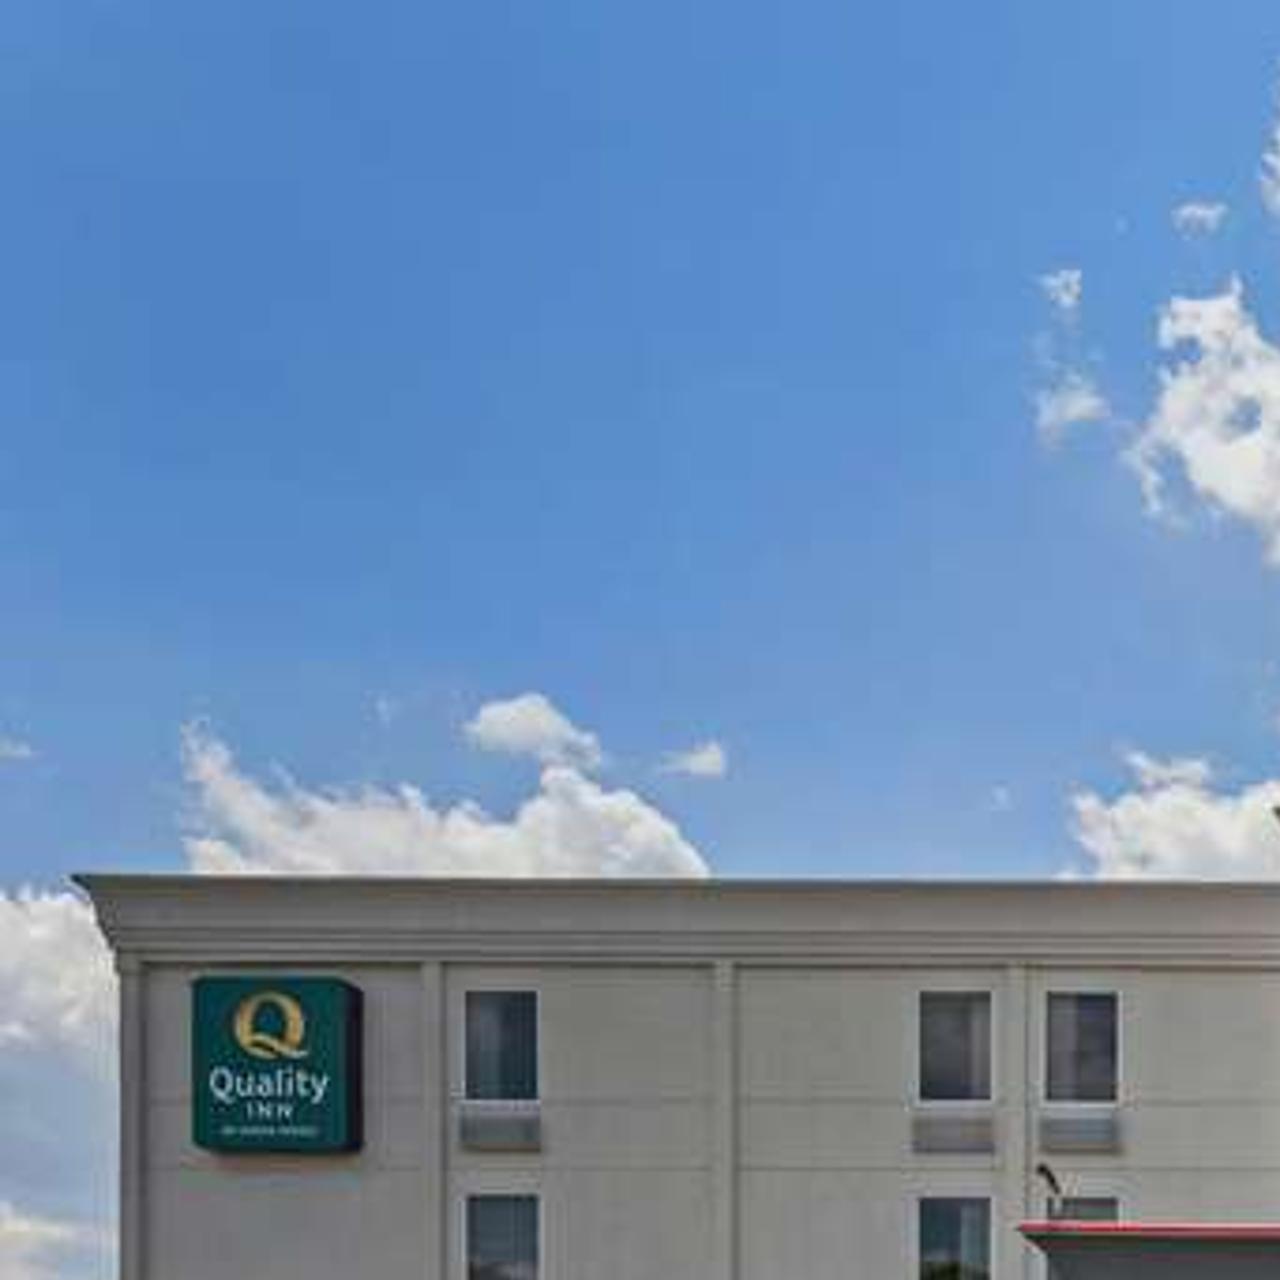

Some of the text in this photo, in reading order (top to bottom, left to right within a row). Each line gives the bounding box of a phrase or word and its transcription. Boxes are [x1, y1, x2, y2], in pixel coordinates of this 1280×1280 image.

[235, 991, 309, 1059] Q
[209, 1066, 328, 1104] Quality
[247, 1102, 295, 1119] INN
